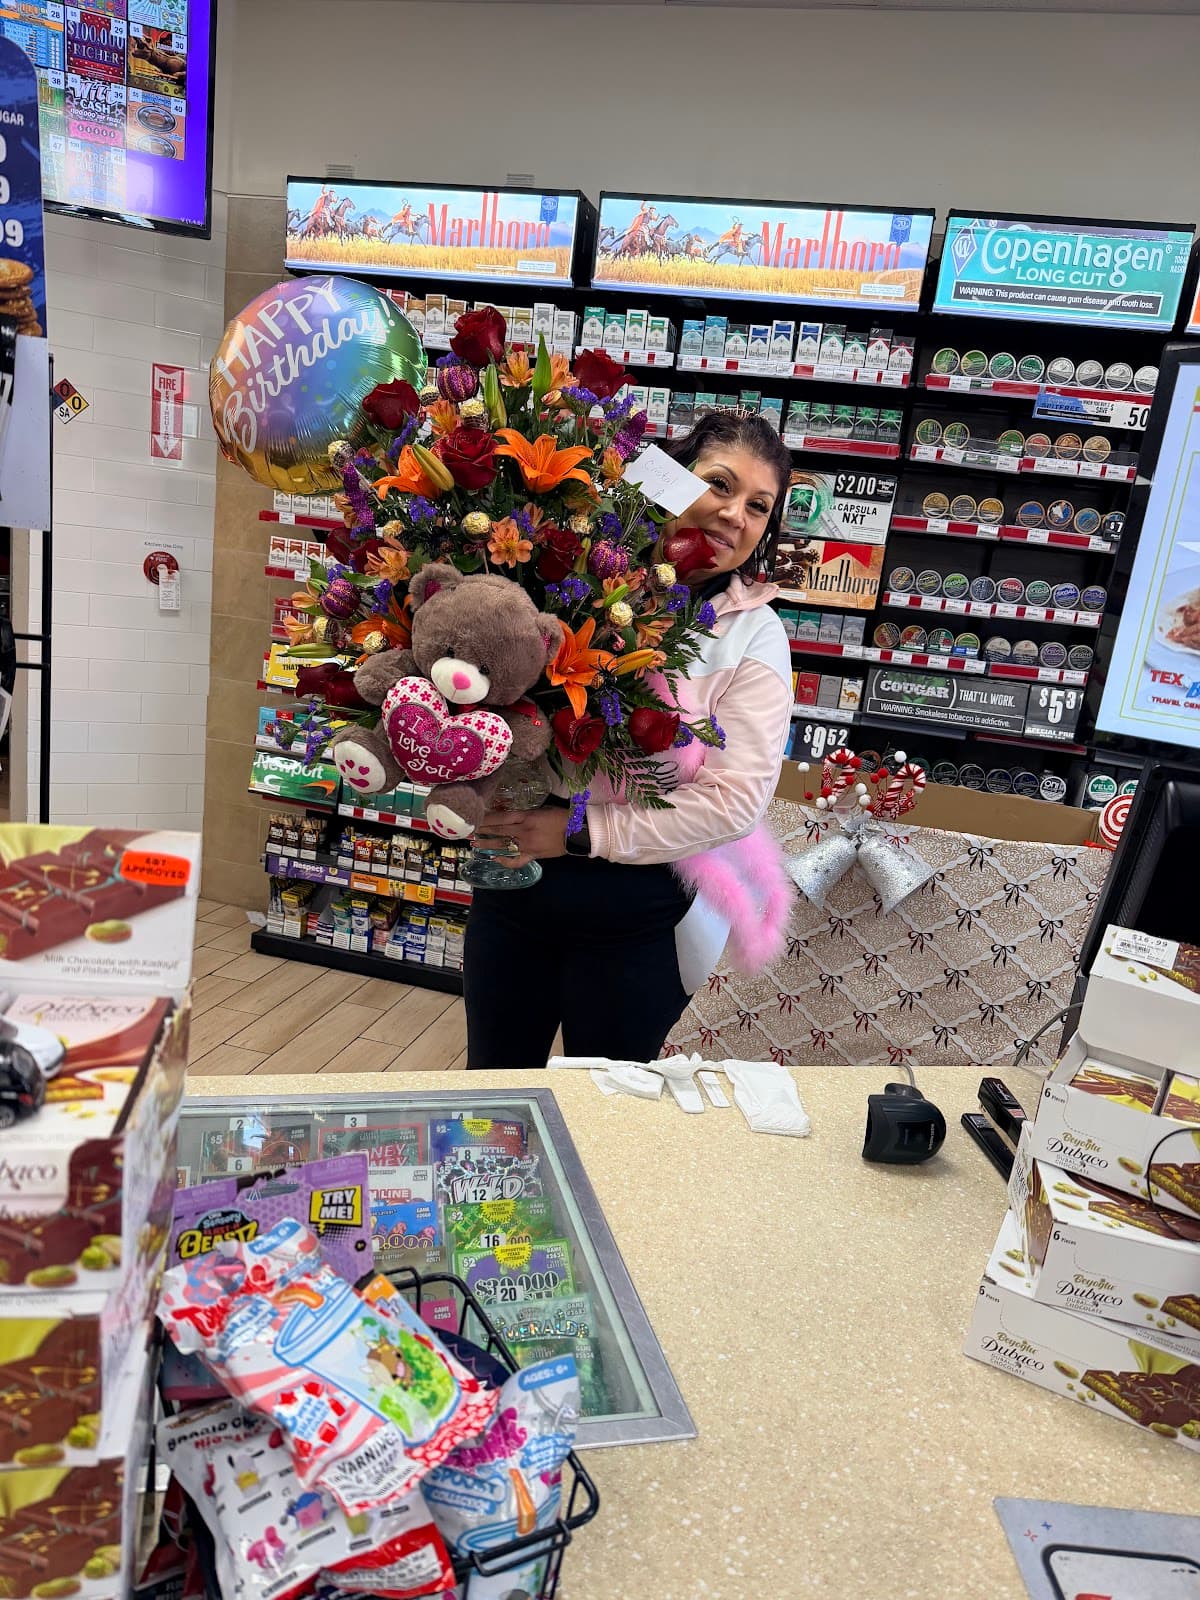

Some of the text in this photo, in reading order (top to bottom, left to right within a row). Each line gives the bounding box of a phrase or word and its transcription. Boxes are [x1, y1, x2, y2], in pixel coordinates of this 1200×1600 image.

[51, 10, 60, 19] 28
[114, 25, 123, 34] 29
[175, 41, 184, 50] 30
[73, 42, 120, 65] RICHER
[51, 77, 61, 86] 38
[114, 91, 123, 100] 39
[81, 98, 111, 114] CASH
[174, 104, 183, 113] 40
[427, 192, 550, 250] Marlboro
[0, 218, 24, 247] 9
[759, 210, 902, 272] Marlboro
[981, 224, 1164, 288] Copenhagen
[1016, 266, 1106, 286] LONG CUT
[959, 286, 1155, 309] WARNING: This product can cause gum disease and tooth loss.
[216, 277, 342, 389] HAPPY
[222, 295, 396, 454] Birthday!
[159, 376, 177, 391] FIRE
[72, 396, 82, 411] 0
[1096, 406, 1108, 414] SAVE
[59, 406, 71, 418] SA
[842, 512, 866, 526] NXT
[806, 560, 879, 596] Marlboro
[1149, 669, 1184, 687] TEX
[880, 679, 1016, 708] COUGAR THAT'LL WORK.
[1151, 696, 1181, 707] TRAVEL
[880, 702, 1012, 728] WARNING: Smokeless tobacco is addictive.
[408, 715, 424, 735] I
[397, 731, 431, 758] Love
[257, 752, 325, 780] Newport
[1092, 783, 1115, 791] VELO
[125, 864, 186, 880] APPROVED
[292, 860, 324, 873] Respect
[1132, 934, 1168, 947] $16.99
[43, 954, 64, 964] Milk
[67, 955, 116, 966] Chocolate
[118, 958, 140, 967] with
[61, 965, 81, 974] and
[1044, 1087, 1052, 1098] 6
[237, 1119, 244, 1130] 2
[350, 1117, 357, 1128] 3
[210, 1135, 223, 1145] $5
[370, 1143, 406, 1158] NEY
[464, 1150, 471, 1160] 8
[1046, 1136, 1109, 1170] Dubaco
[235, 1159, 242, 1171] 6
[322, 1189, 356, 1205] TRY
[381, 1190, 410, 1199] LINE
[473, 1189, 487, 1201] 12
[320, 1205, 354, 1221] ME!
[451, 1211, 464, 1221] $2
[484, 1234, 500, 1248] 16
[1053, 1230, 1061, 1241] 6
[463, 1257, 477, 1268] $2
[501, 1287, 517, 1302] 20
[979, 1285, 986, 1296] 6
[1056, 1279, 1124, 1307] Dubaco
[981, 1335, 1046, 1372] Dubaco
[523, 1368, 555, 1385] AGES:
